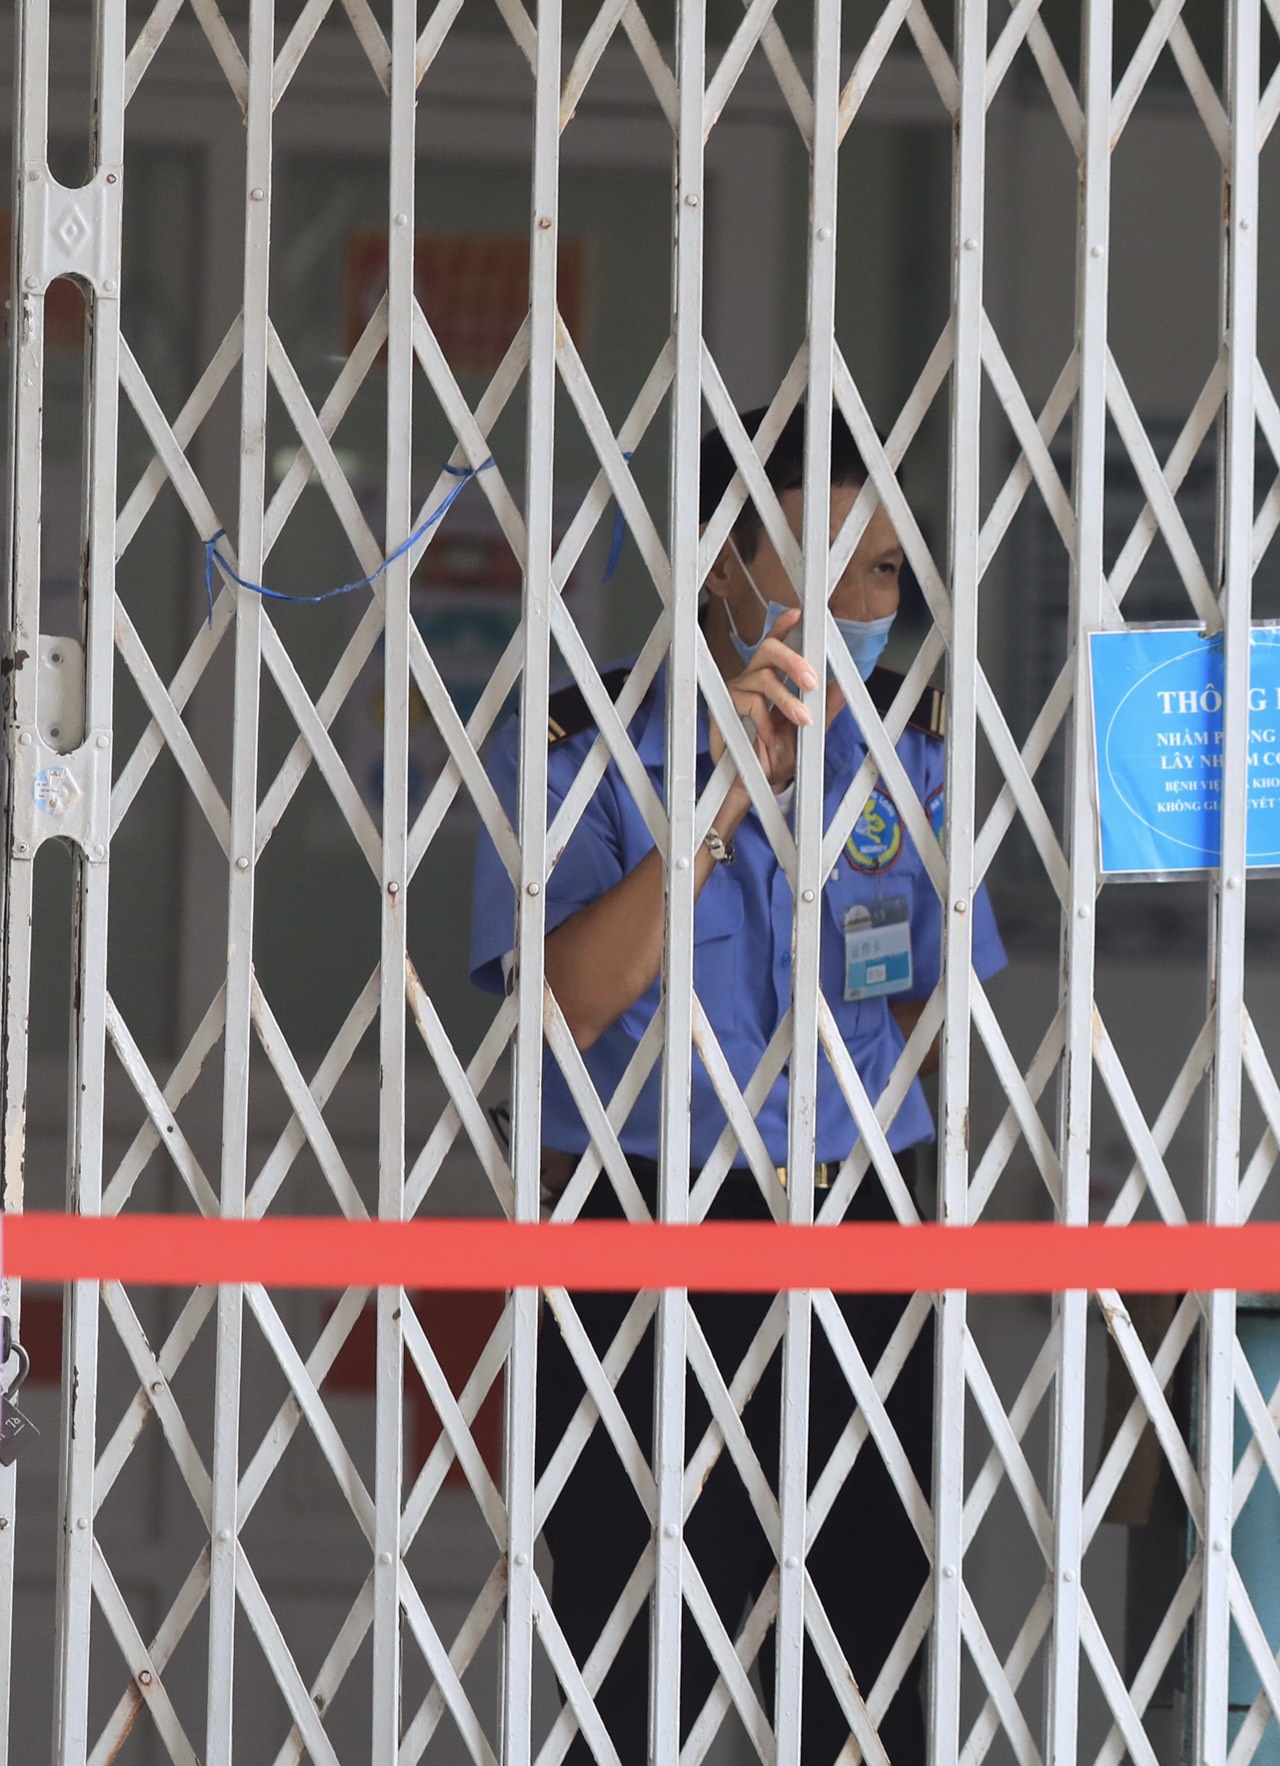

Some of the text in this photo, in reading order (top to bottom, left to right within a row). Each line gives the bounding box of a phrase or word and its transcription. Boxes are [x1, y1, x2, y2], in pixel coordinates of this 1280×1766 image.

[1156, 683, 1268, 715] THÔG
[1214, 728, 1277, 746] PNG
[1160, 751, 1195, 770] LÂY
[1200, 752, 1260, 769] NHM
[1164, 779, 1198, 794] BỆNH
[1200, 778, 1222, 793] VIỆ
[1156, 799, 1202, 813] KHÔNG
